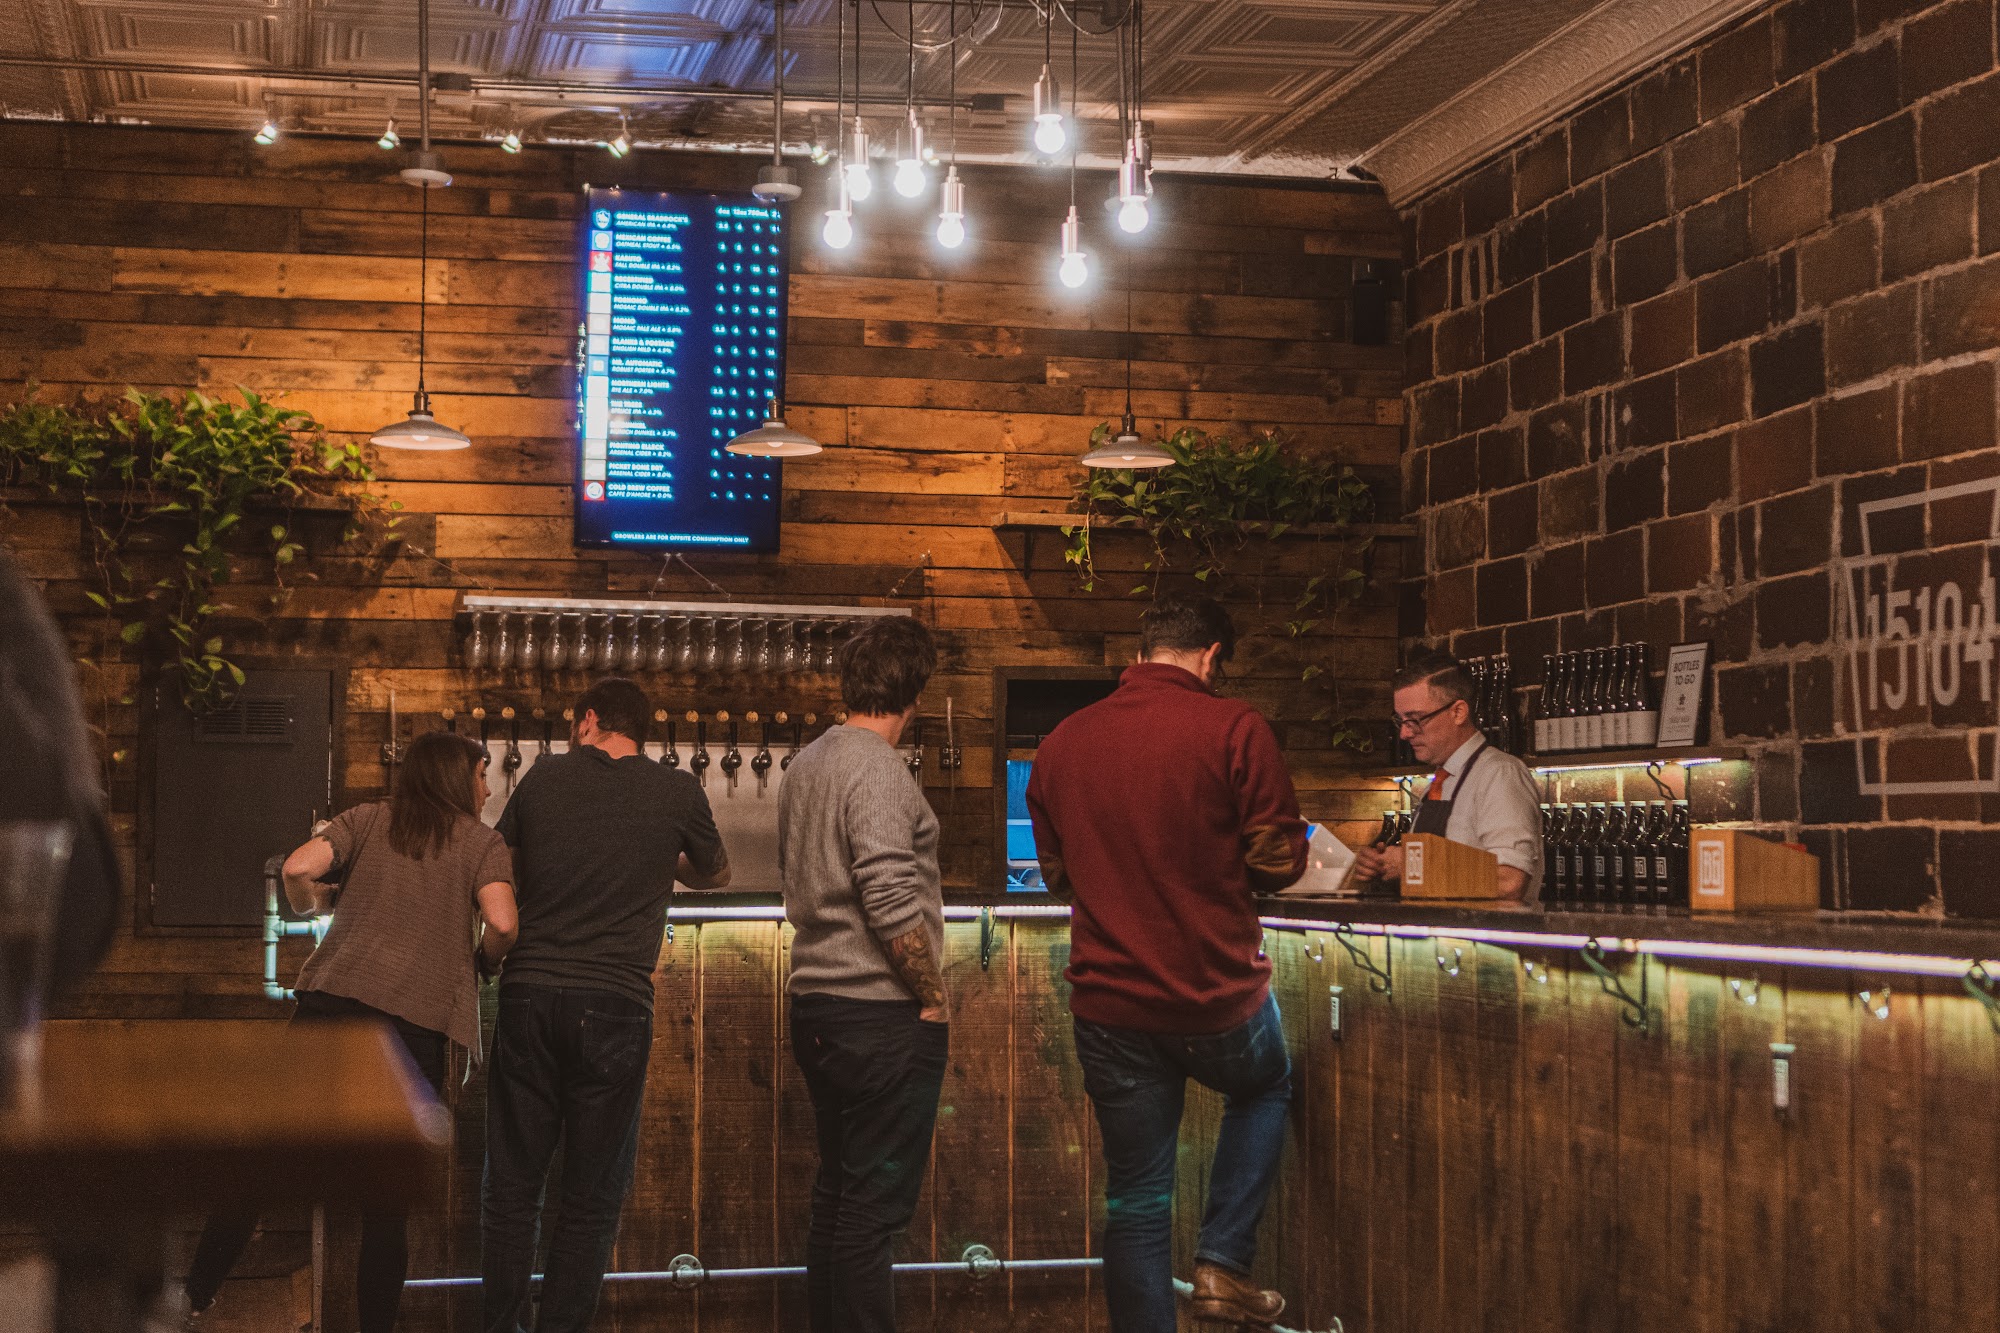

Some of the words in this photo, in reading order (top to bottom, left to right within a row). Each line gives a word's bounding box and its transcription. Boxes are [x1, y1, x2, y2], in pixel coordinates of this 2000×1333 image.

[616, 213, 646, 221] GENERAL
[647, 215, 688, 223] BRADDOCK'S
[1866, 576, 1999, 711] 15104
[1673, 660, 1699, 672] BOTTLES
[1674, 675, 1683, 686] TO
[1684, 674, 1696, 684] GO
